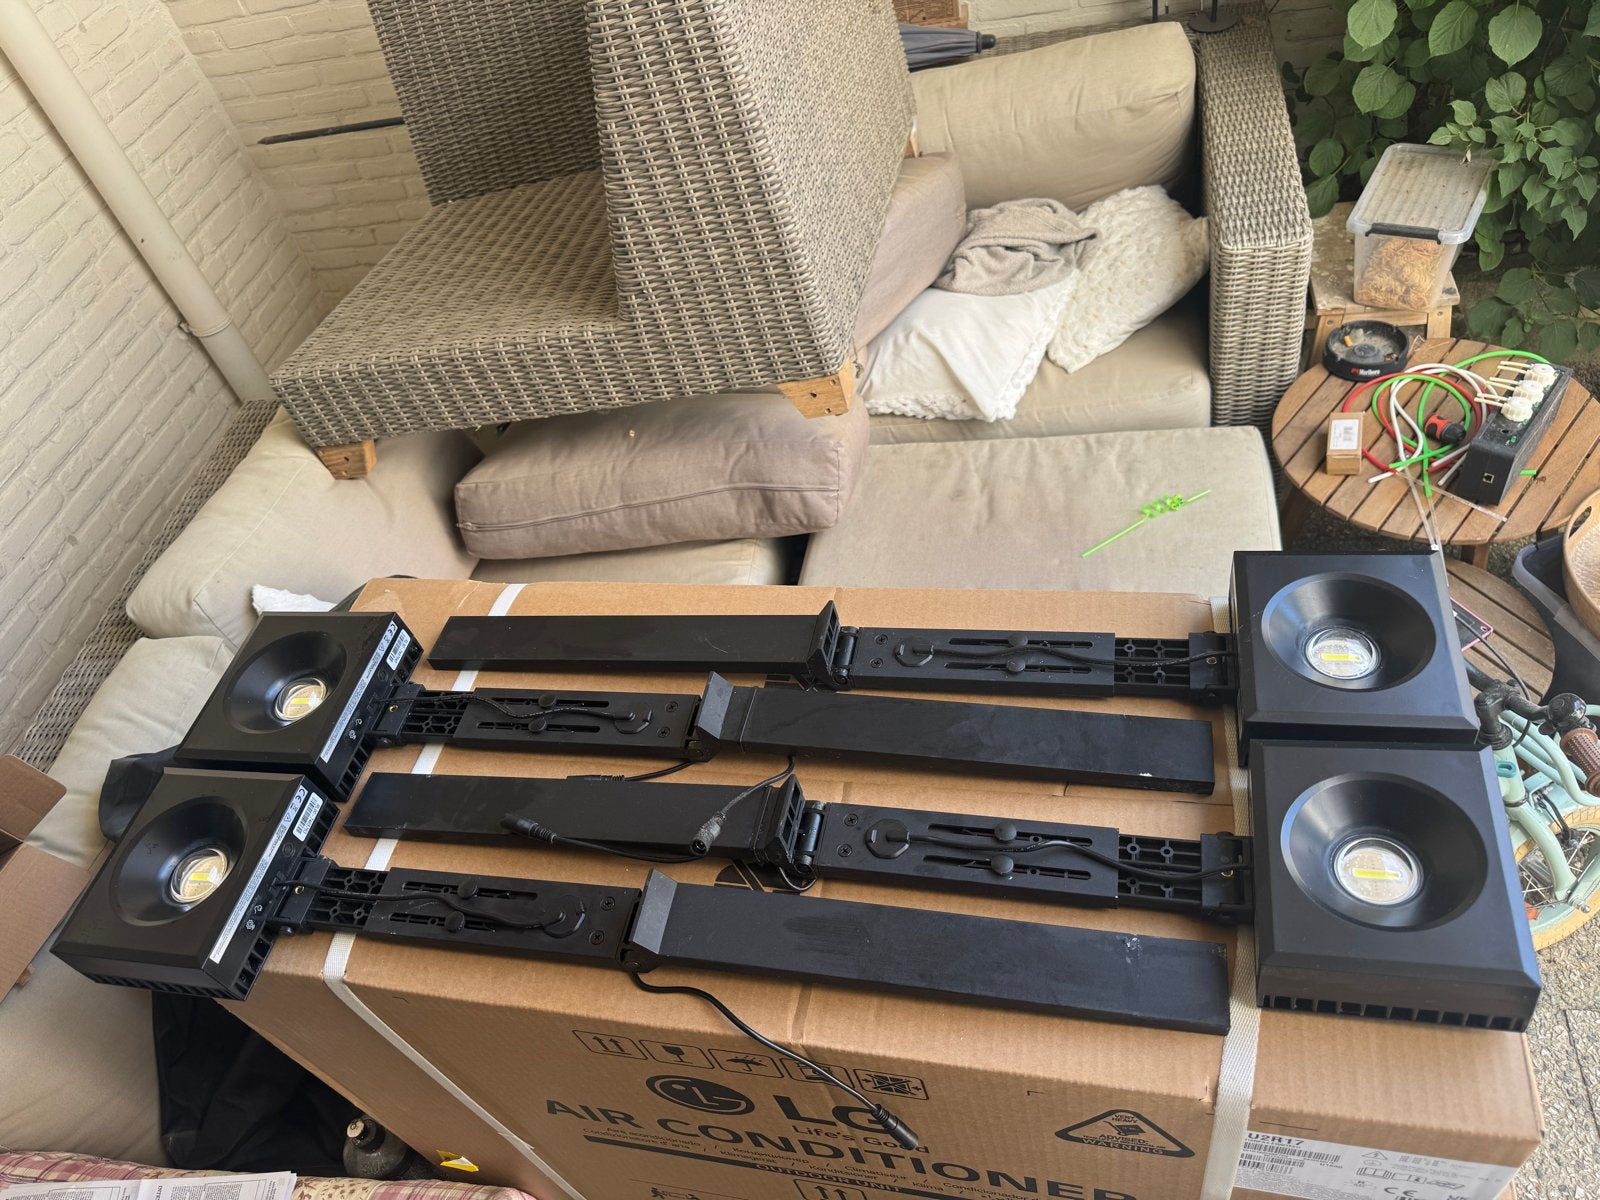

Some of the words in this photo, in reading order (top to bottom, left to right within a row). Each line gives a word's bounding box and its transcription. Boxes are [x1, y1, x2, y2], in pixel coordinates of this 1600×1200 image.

[546, 1100, 645, 1129] AIR
[772, 1094, 893, 1135] LG
[791, 1125, 855, 1142] Life's
[862, 1136, 930, 1154] God
[1082, 1138, 1164, 1154] WARNING
[756, 1164, 849, 1184] OUTDOOR
[912, 1181, 944, 1192] Klima
